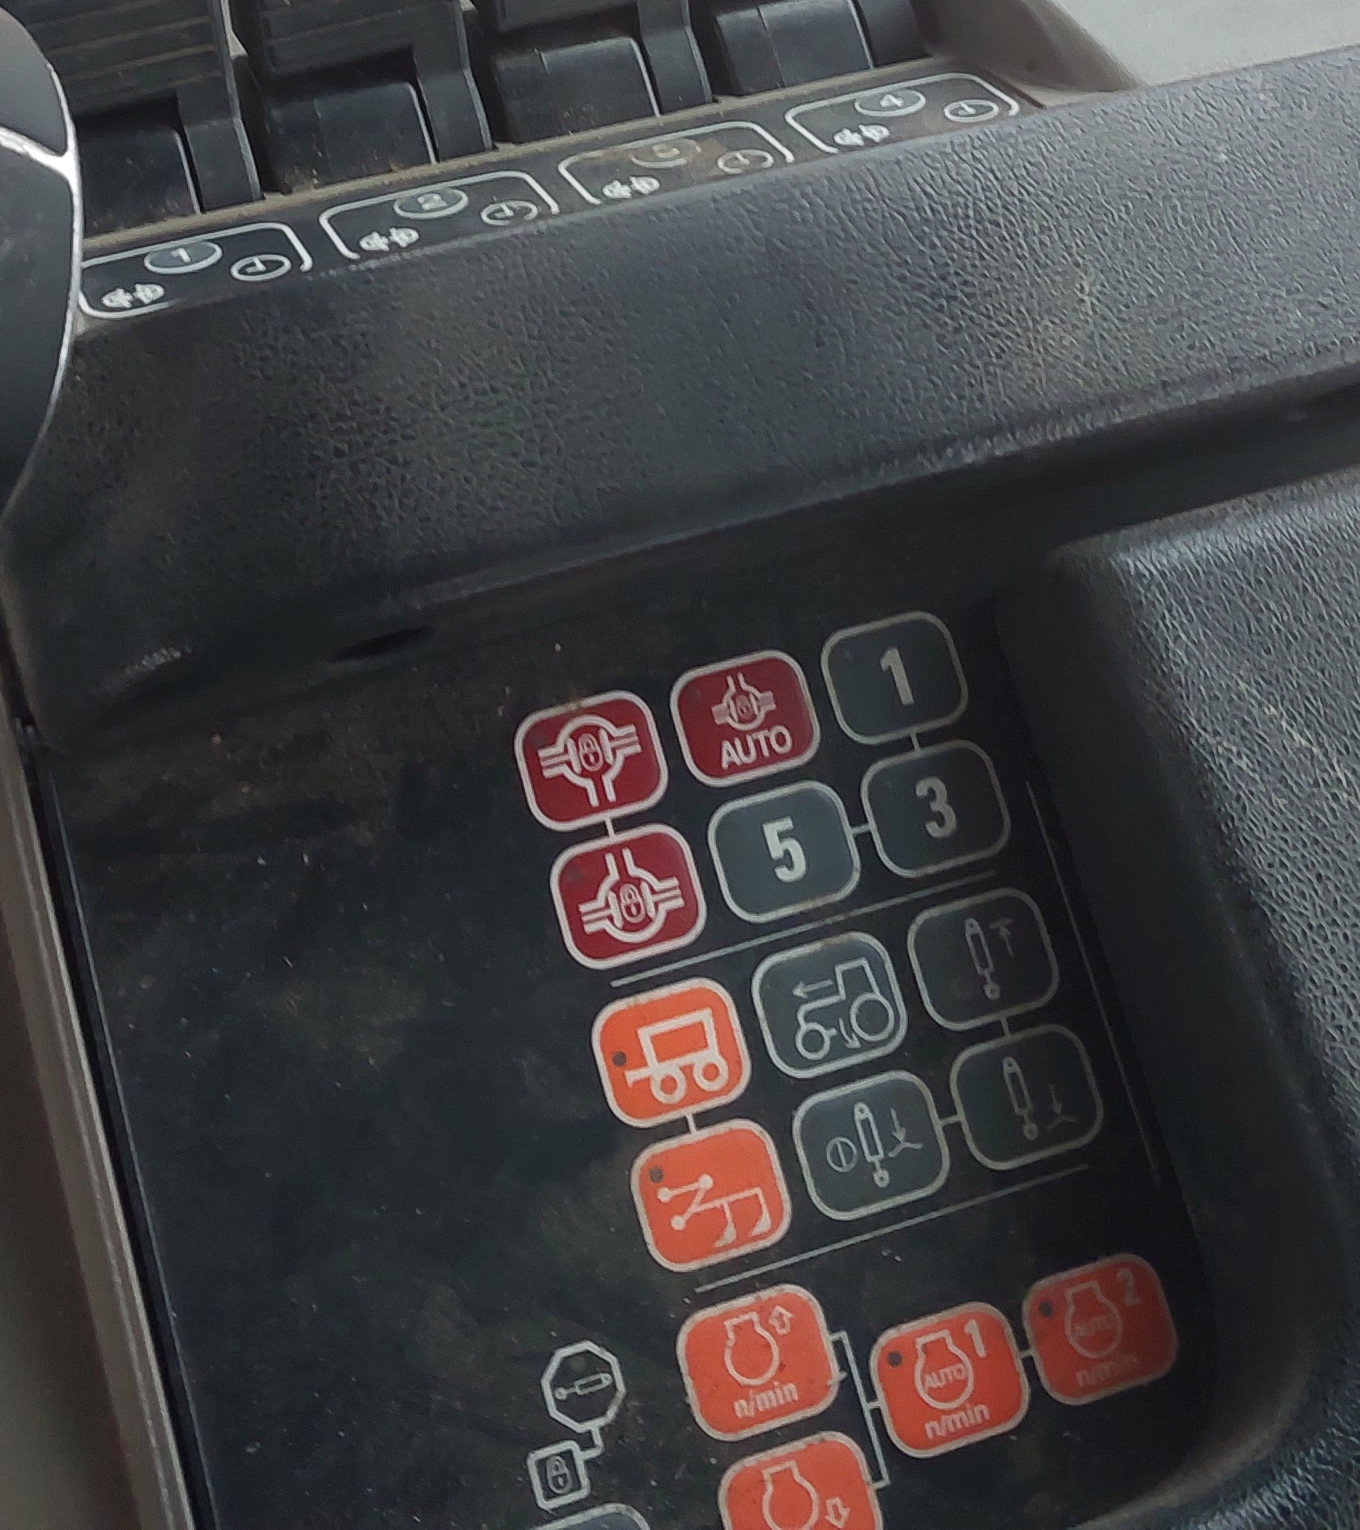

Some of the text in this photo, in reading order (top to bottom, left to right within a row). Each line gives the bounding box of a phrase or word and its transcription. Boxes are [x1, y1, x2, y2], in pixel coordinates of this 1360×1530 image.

[880, 645, 915, 706] 1
[721, 725, 793, 770] AUTO
[915, 776, 958, 839] 3
[762, 816, 807, 883] 5
[1116, 1267, 1142, 1307] 2
[963, 1319, 987, 1358] 1
[923, 1363, 966, 1390] AUTO
[733, 1381, 798, 1419] n/min
[924, 1403, 990, 1440] n/min
